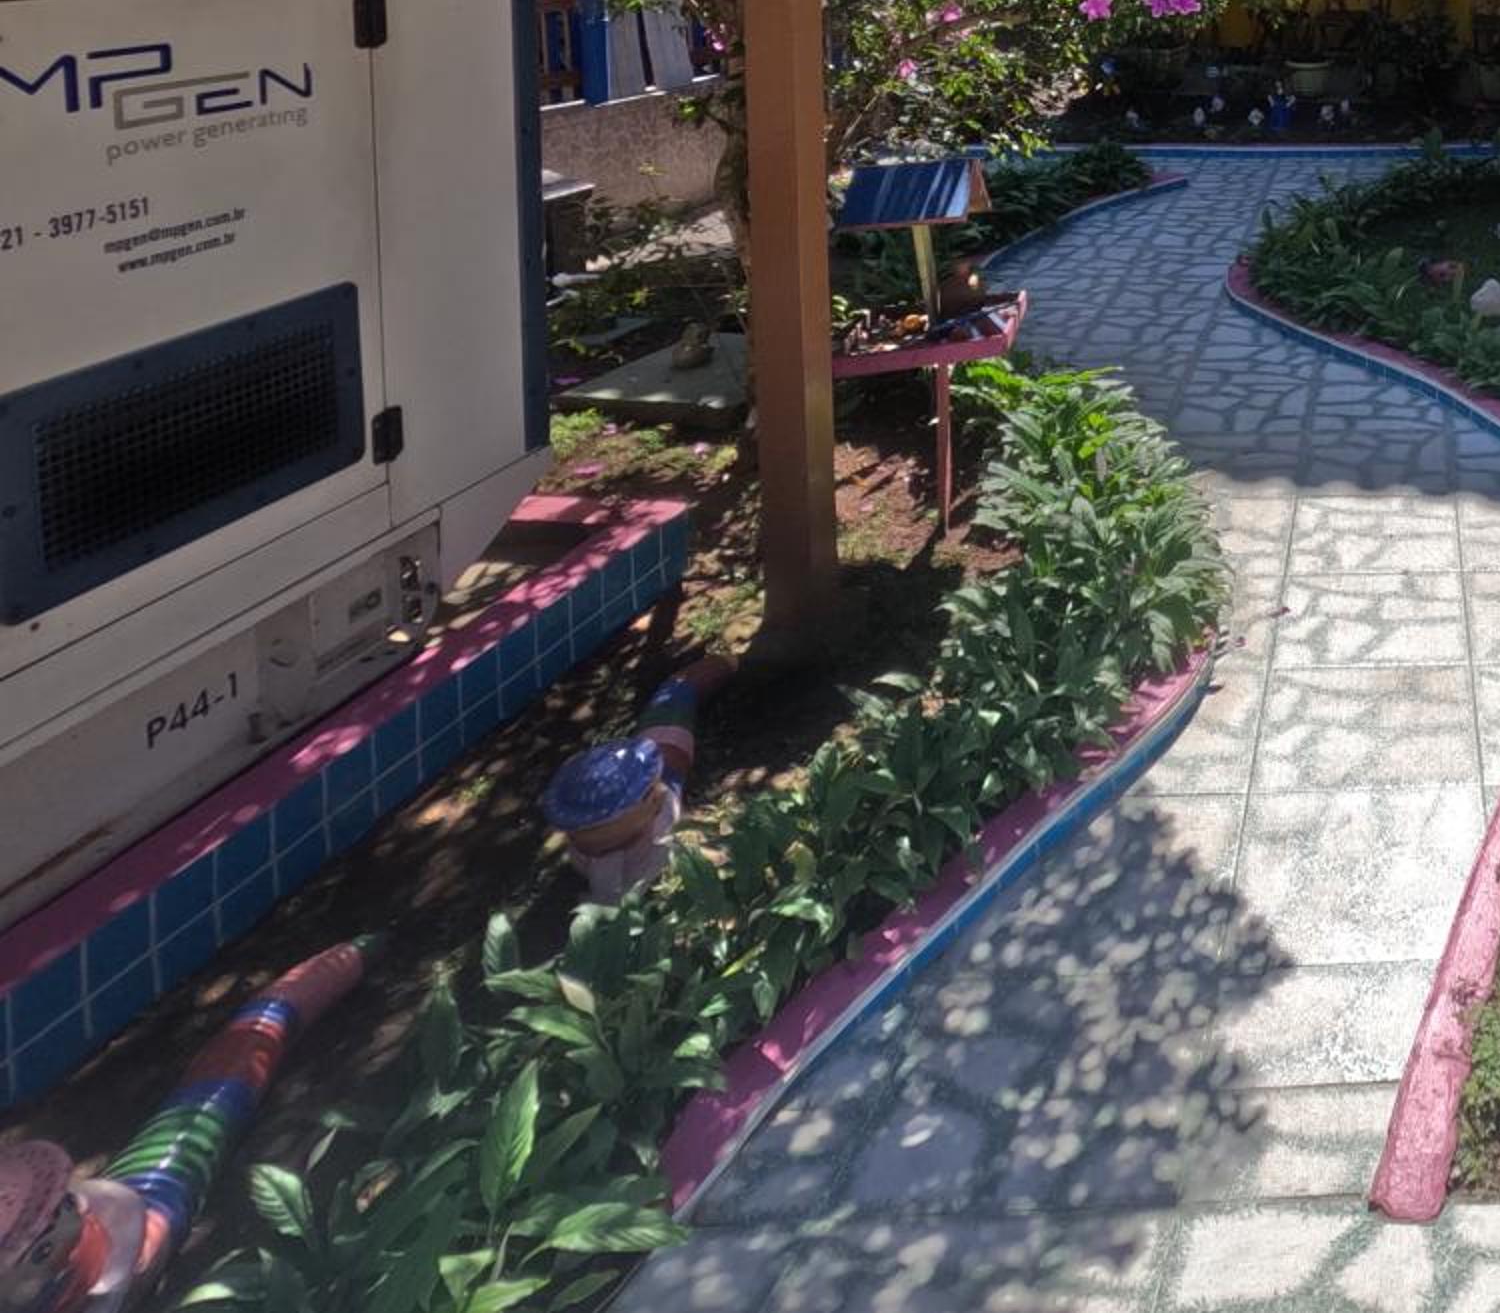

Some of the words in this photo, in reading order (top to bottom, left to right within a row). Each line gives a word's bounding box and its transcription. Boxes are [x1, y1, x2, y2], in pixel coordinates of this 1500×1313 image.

[106, 128, 187, 166] power
[193, 107, 308, 148] generating
[48, 196, 149, 239] 3977-5151
[147, 670, 237, 749] P44-1
